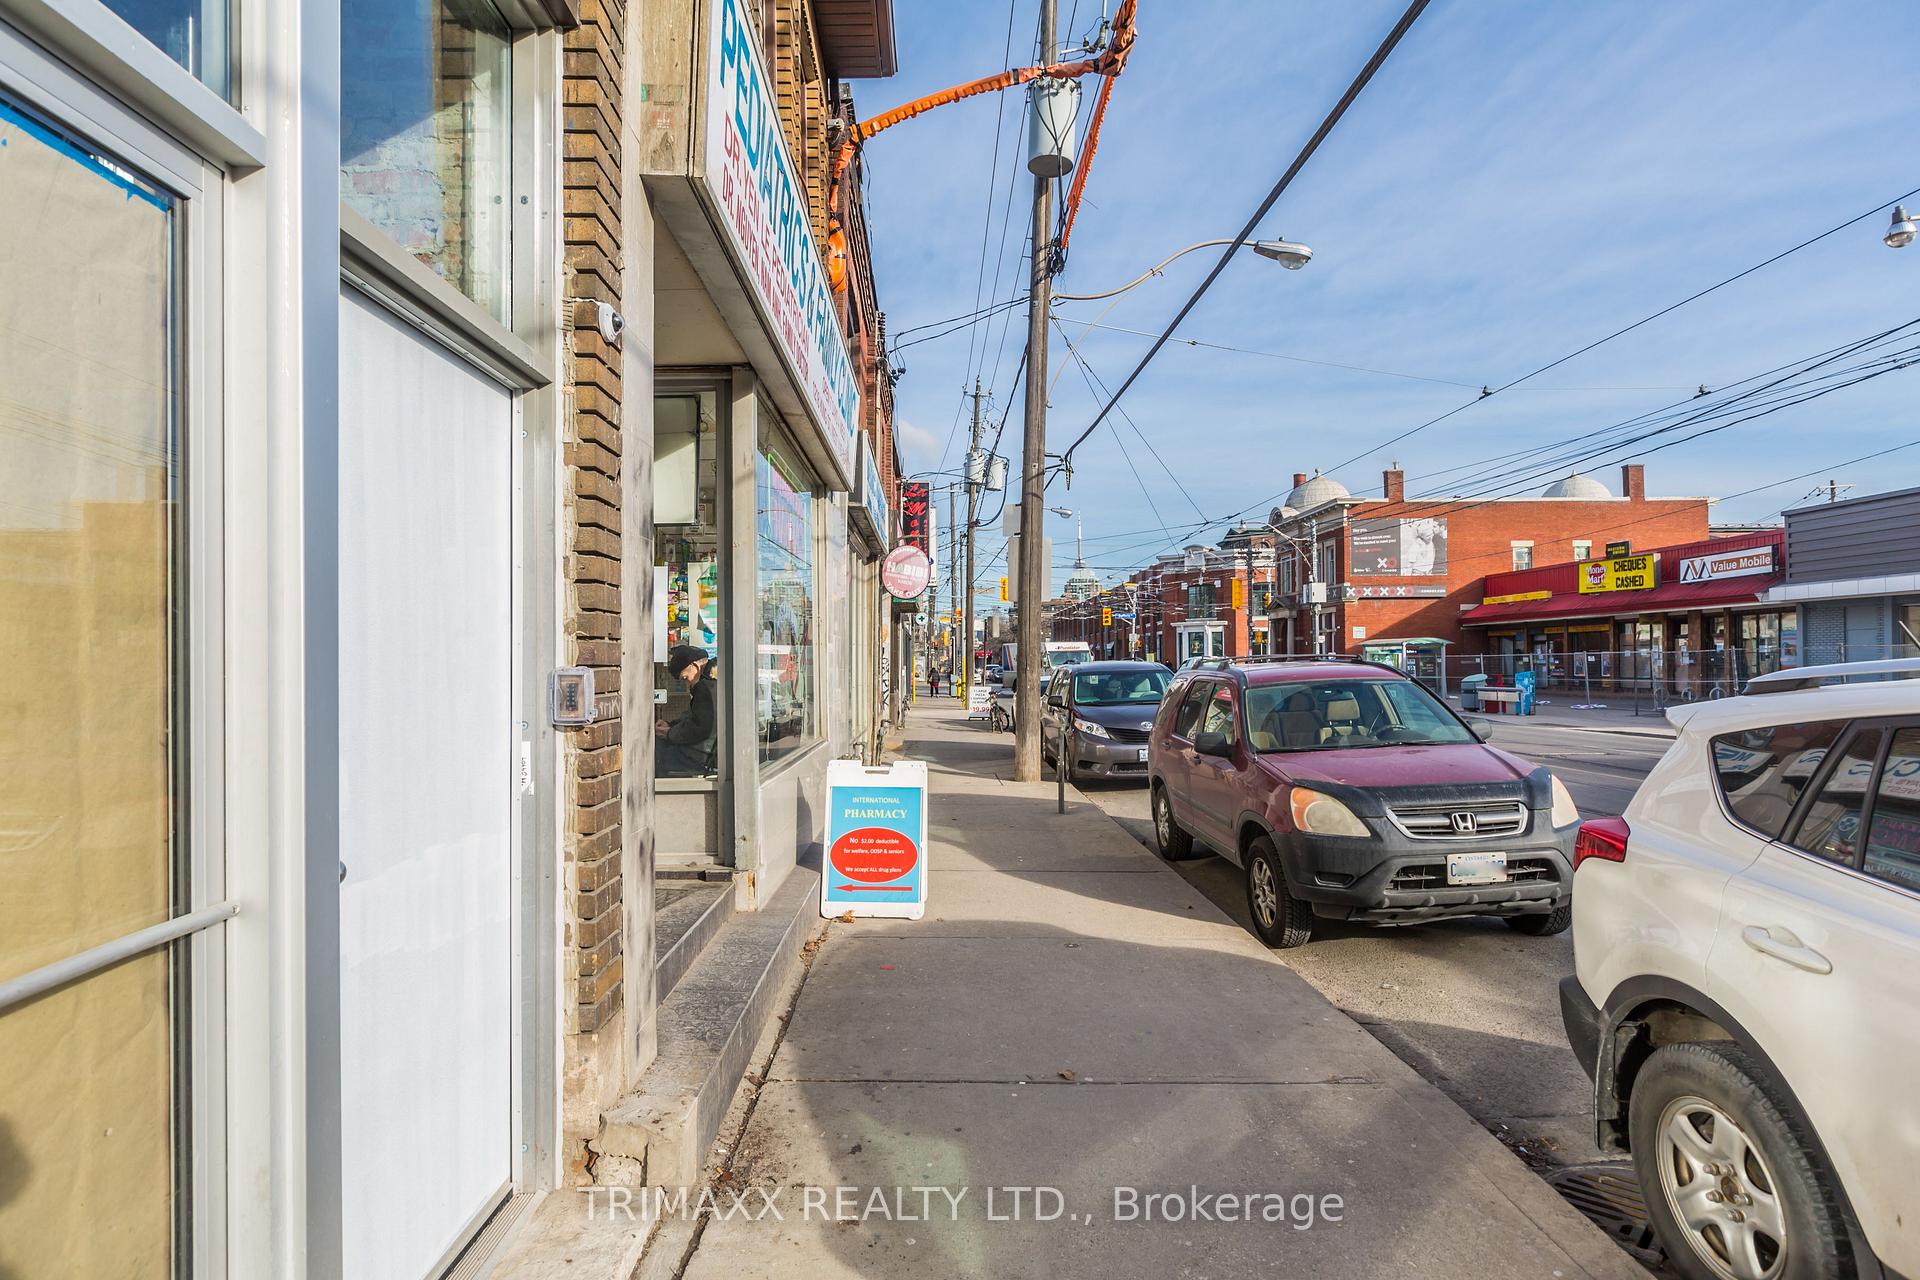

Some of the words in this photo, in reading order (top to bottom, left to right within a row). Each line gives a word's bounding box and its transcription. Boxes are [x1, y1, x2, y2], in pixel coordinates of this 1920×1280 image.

[720, 0, 809, 310] PEDIATRICS
[807, 262, 816, 334] &
[724, 111, 742, 187] DR.
[743, 157, 760, 233] YEN
[723, 162, 734, 220] DR.
[1585, 565, 1607, 575] Money
[1613, 557, 1647, 572] CHEQUES
[1711, 561, 1737, 571] Value
[1739, 555, 1771, 568] Mobile
[1587, 573, 1606, 584] Mart
[1615, 574, 1644, 588] CASHED
[886, 581, 904, 596] TAKE
[905, 588, 921, 597] OUT
[844, 809, 907, 819] PHARMACY
